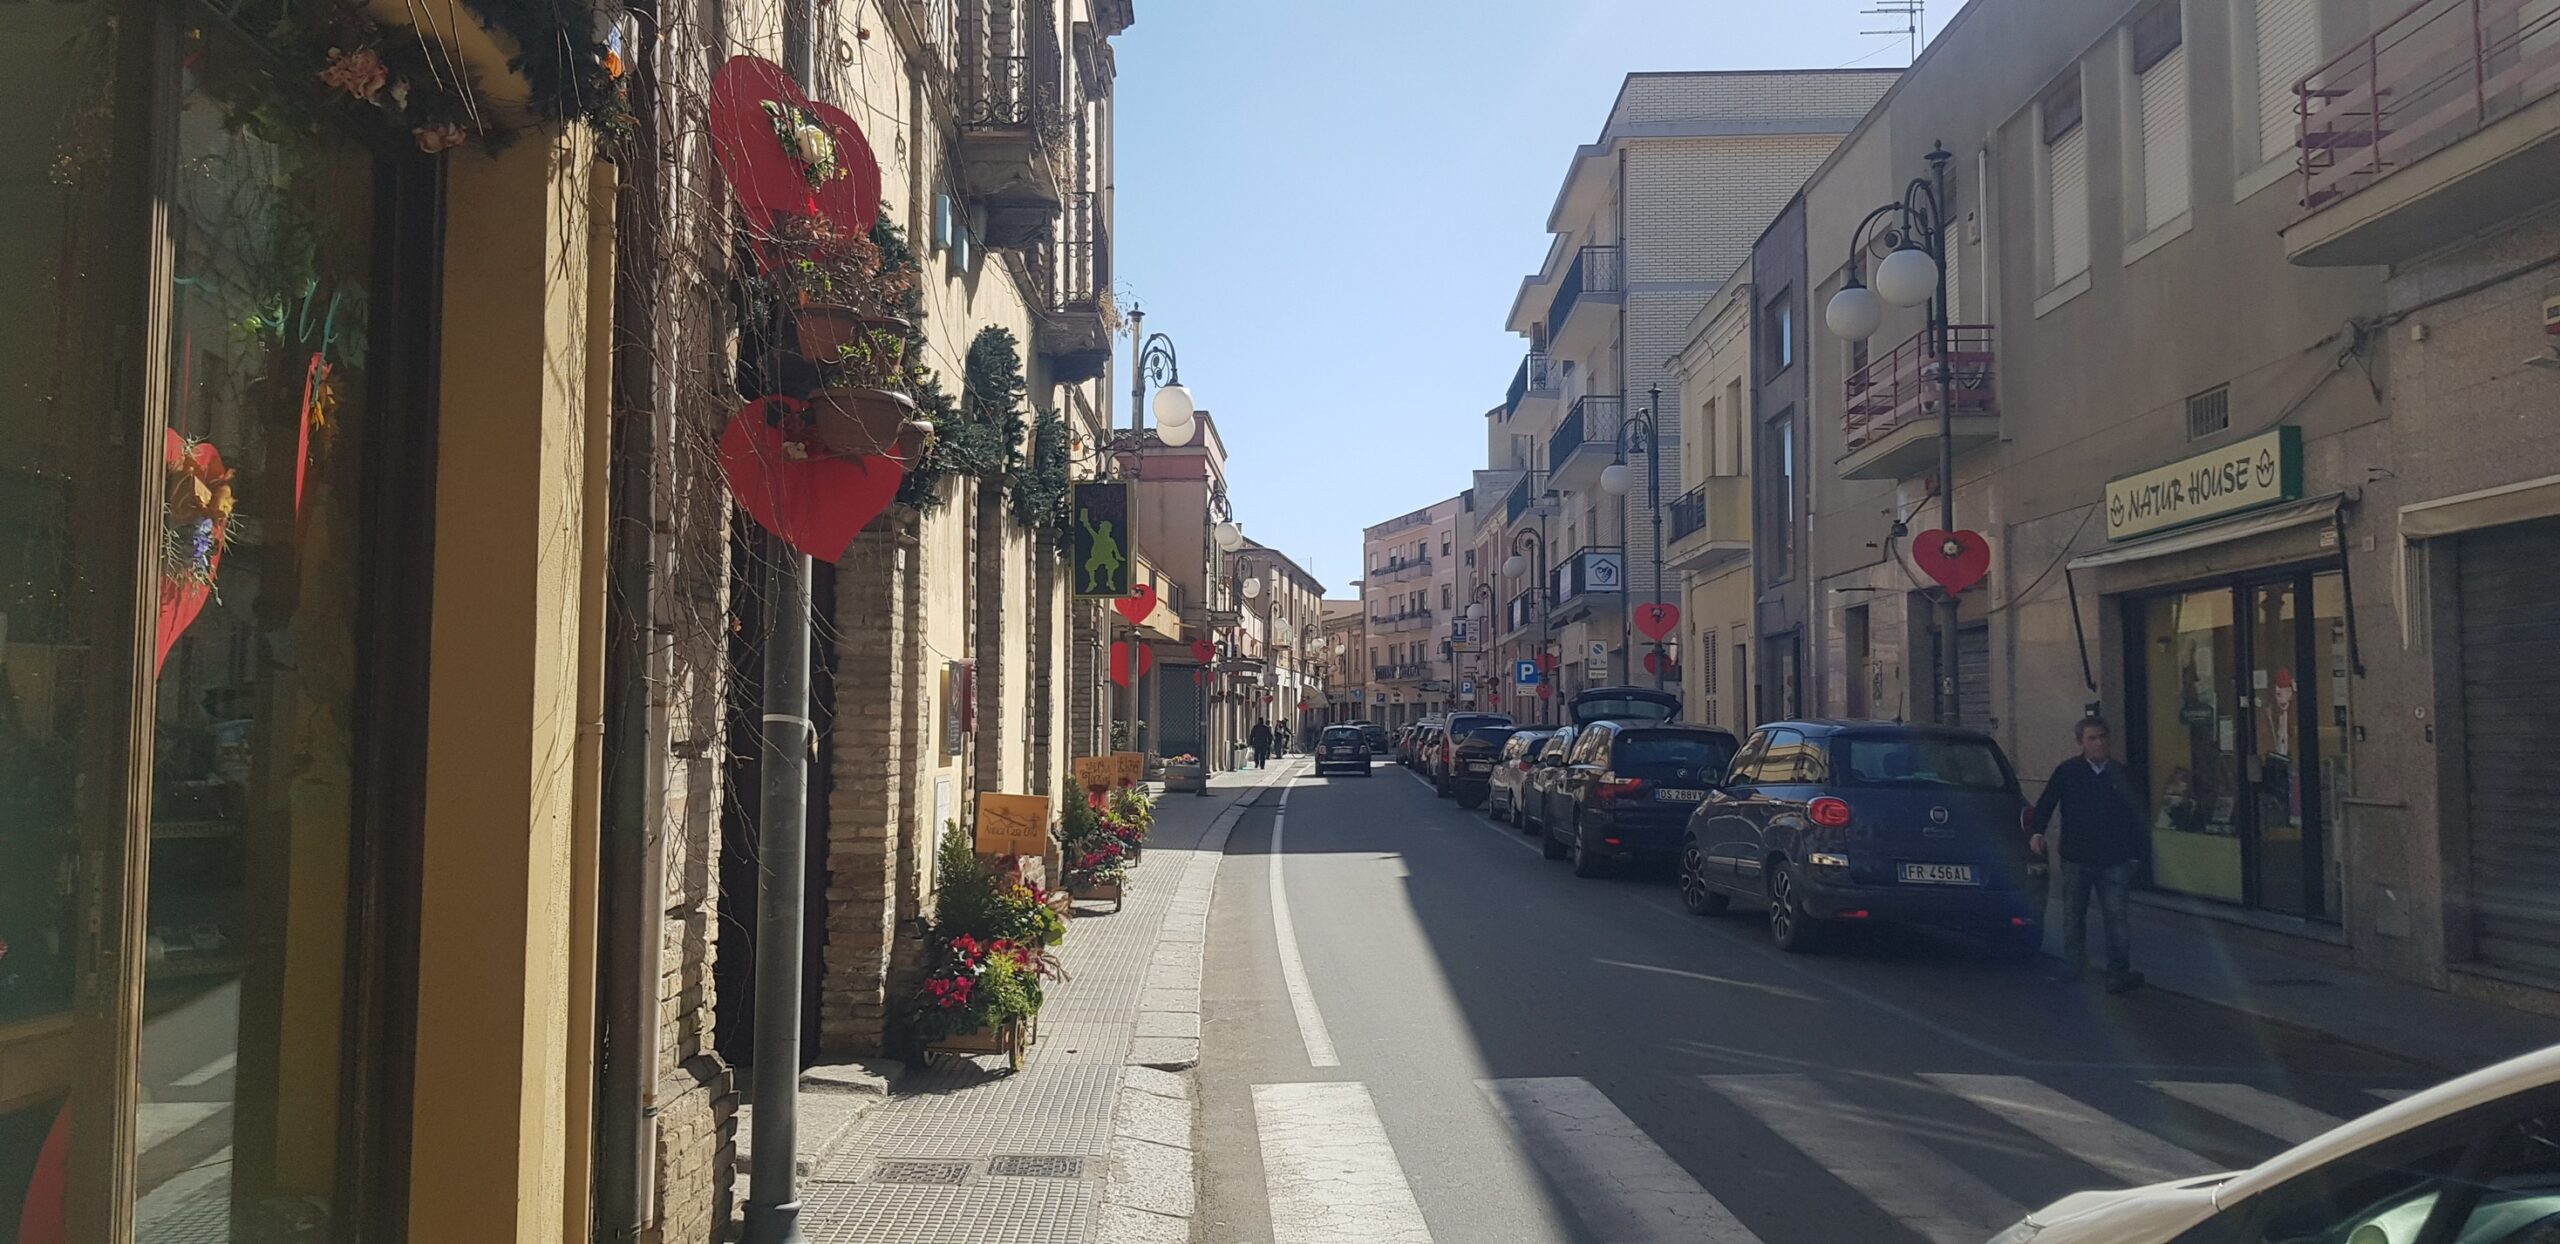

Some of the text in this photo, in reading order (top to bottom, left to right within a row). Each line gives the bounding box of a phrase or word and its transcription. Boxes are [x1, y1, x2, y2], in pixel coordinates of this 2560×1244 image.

[2128, 457, 2250, 521] NATUR HOUSE
[1521, 663, 1534, 681] P
[1908, 865, 1968, 880] FR 456AL
